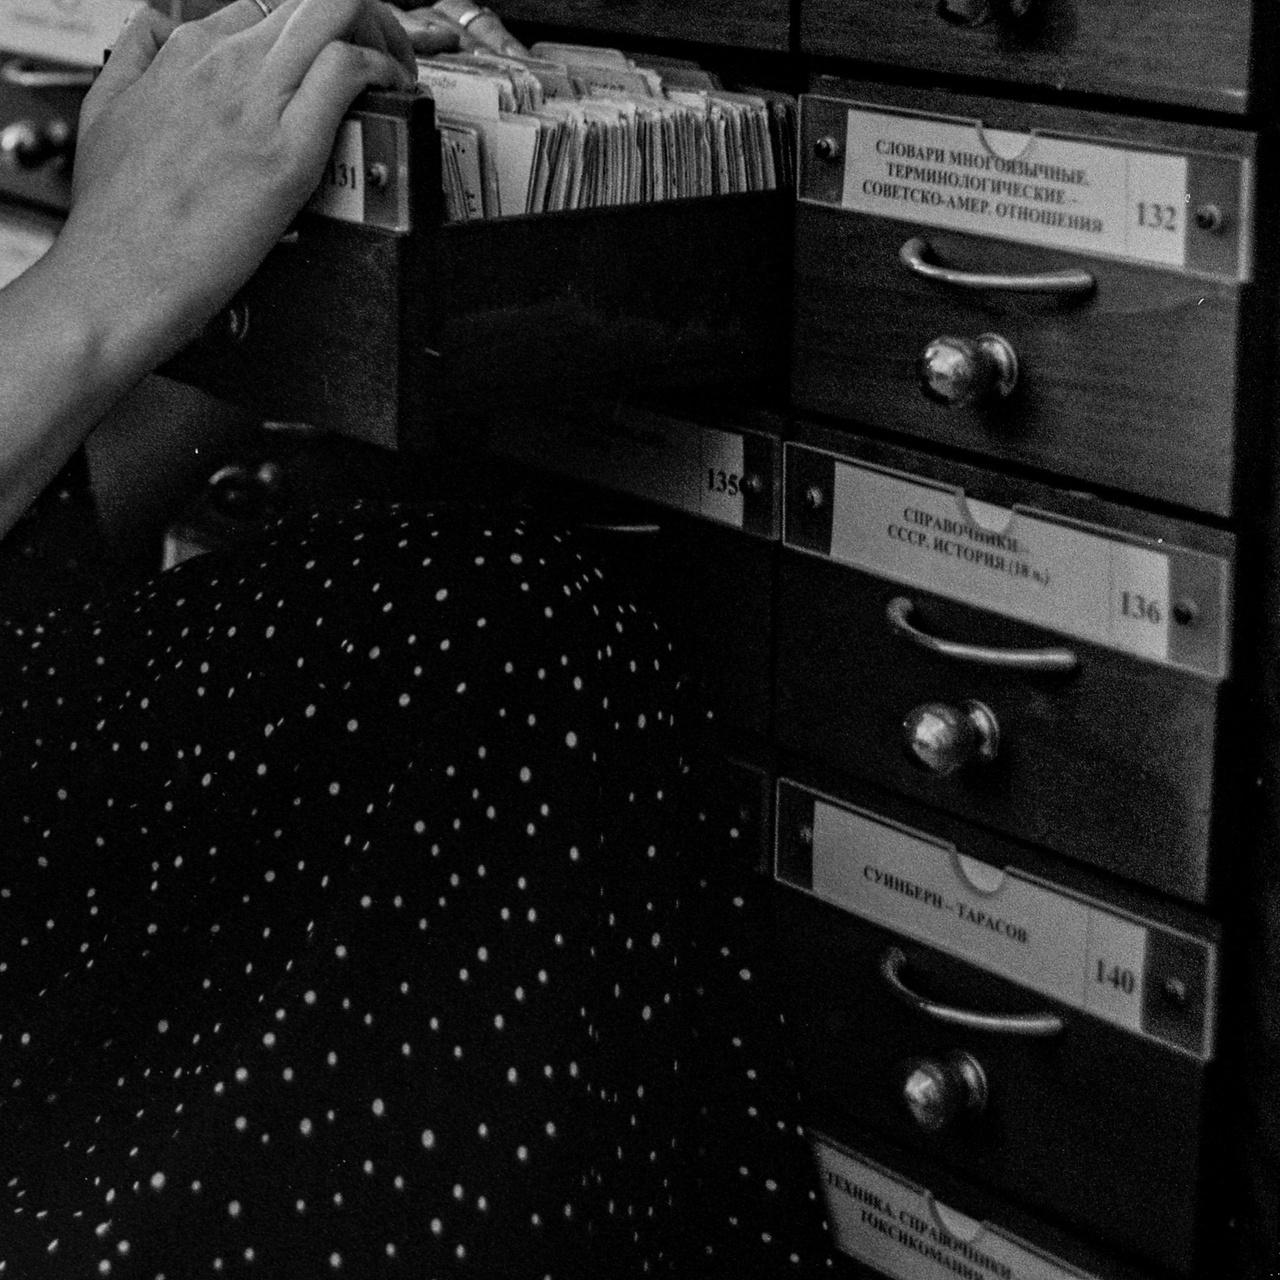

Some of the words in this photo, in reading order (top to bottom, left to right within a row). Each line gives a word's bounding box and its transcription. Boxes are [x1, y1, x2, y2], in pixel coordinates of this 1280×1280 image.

[876, 138, 945, 163] СЛОВАРИ
[887, 162, 1065, 206] ТЕРМИНОЛОГИЧЕСКИЕ
[863, 179, 992, 214] СОВЕТСКО-АМЕР.
[995, 201, 1103, 233] ОТНОШЕНИЯ
[1135, 201, 1176, 231] 132
[708, 468, 738, 496] 135
[888, 524, 929, 548] СССР.
[934, 536, 1005, 571] ИСТОРИЯ
[904, 506, 1018, 553] СПРАВОЧНИКИ
[1122, 591, 1160, 624] 136
[956, 902, 1027, 944] ТАРАСОВ
[1096, 959, 1134, 995] 140
